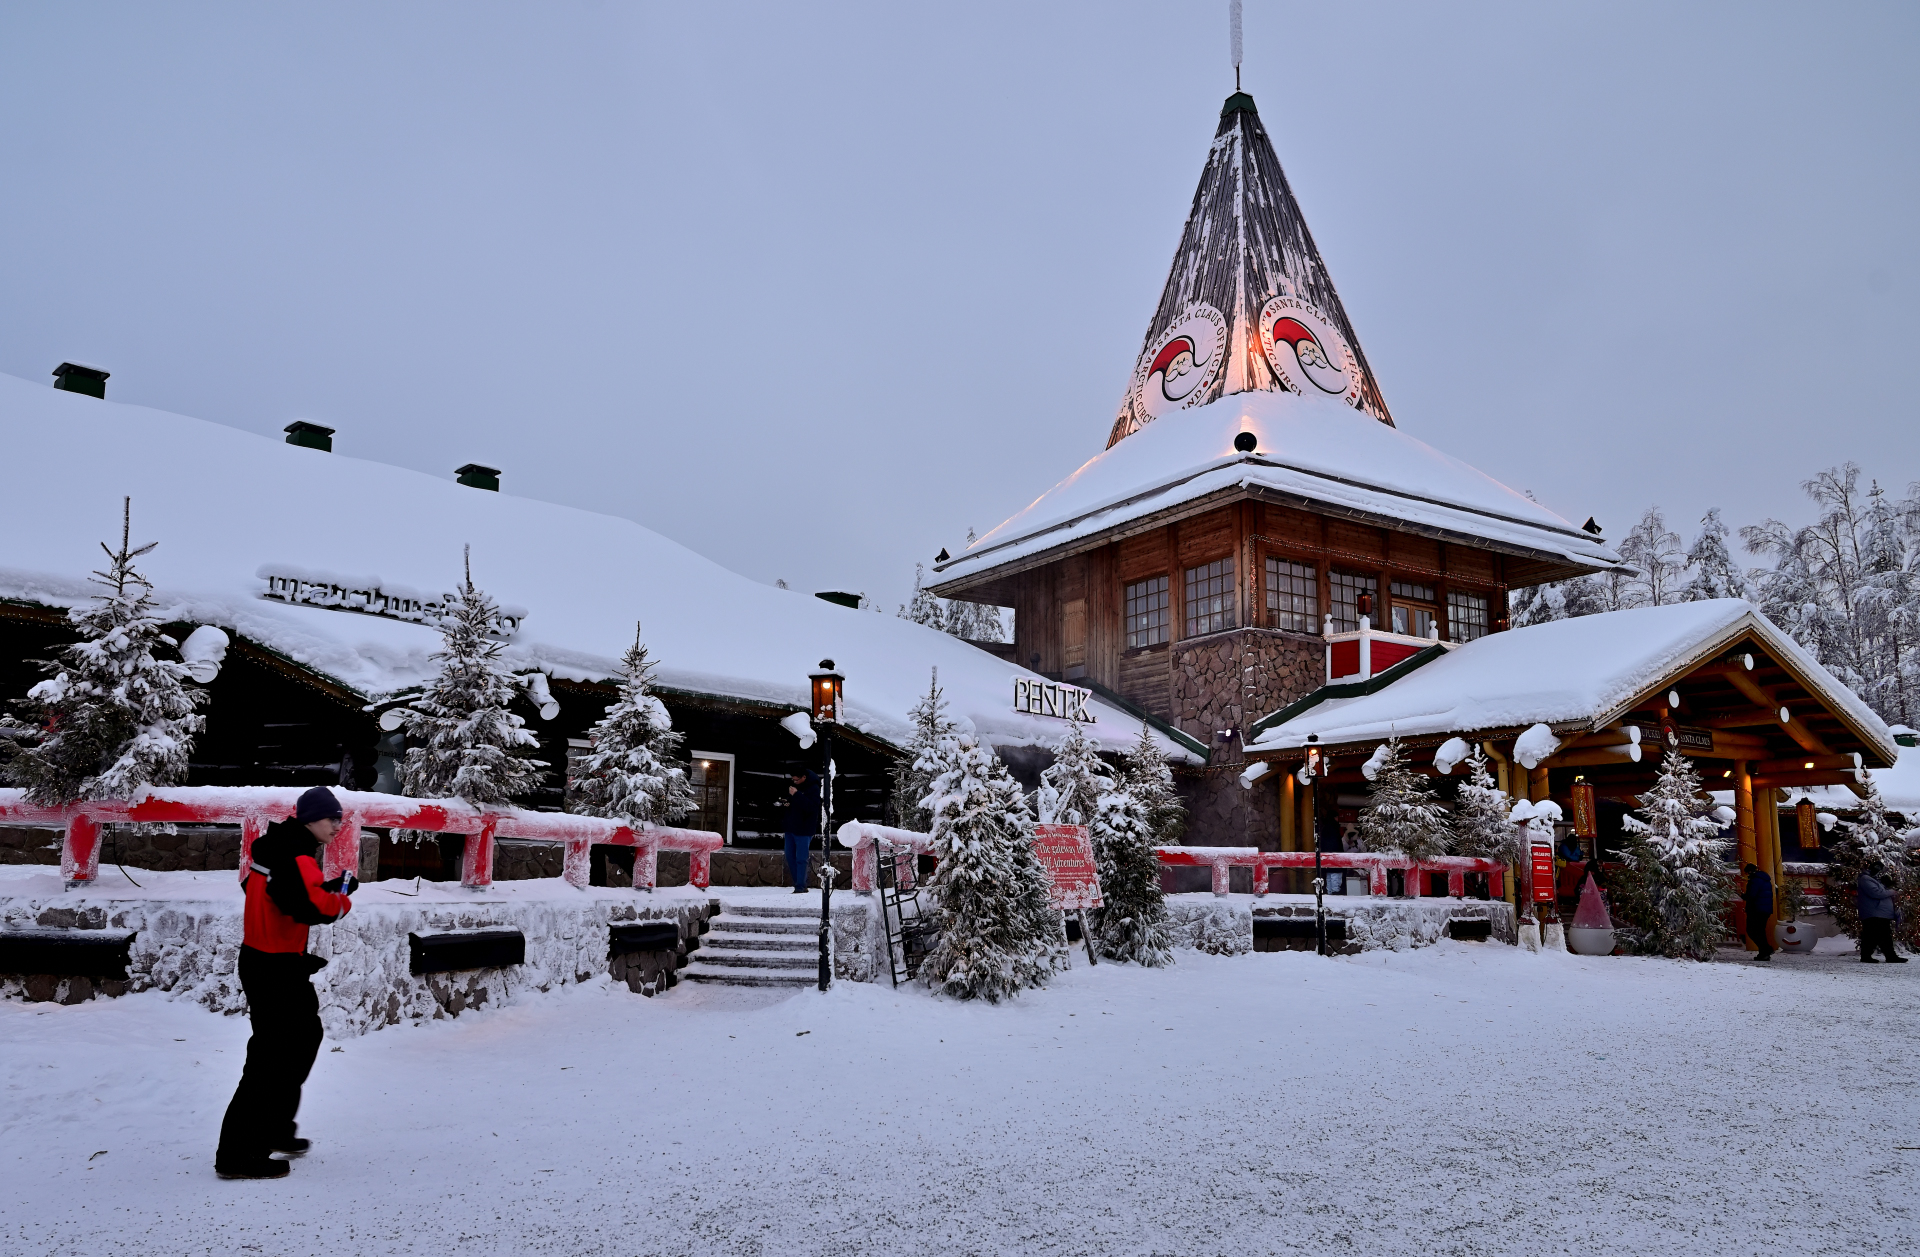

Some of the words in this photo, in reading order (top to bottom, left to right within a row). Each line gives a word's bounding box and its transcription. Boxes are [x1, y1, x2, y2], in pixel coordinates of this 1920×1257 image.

[1194, 308, 1222, 327] CLAUS
[1269, 298, 1302, 314] SANTA
[1156, 312, 1191, 347] SANTA
[1207, 326, 1225, 377] OFFICE
[1135, 356, 1152, 402] ARCTIC
